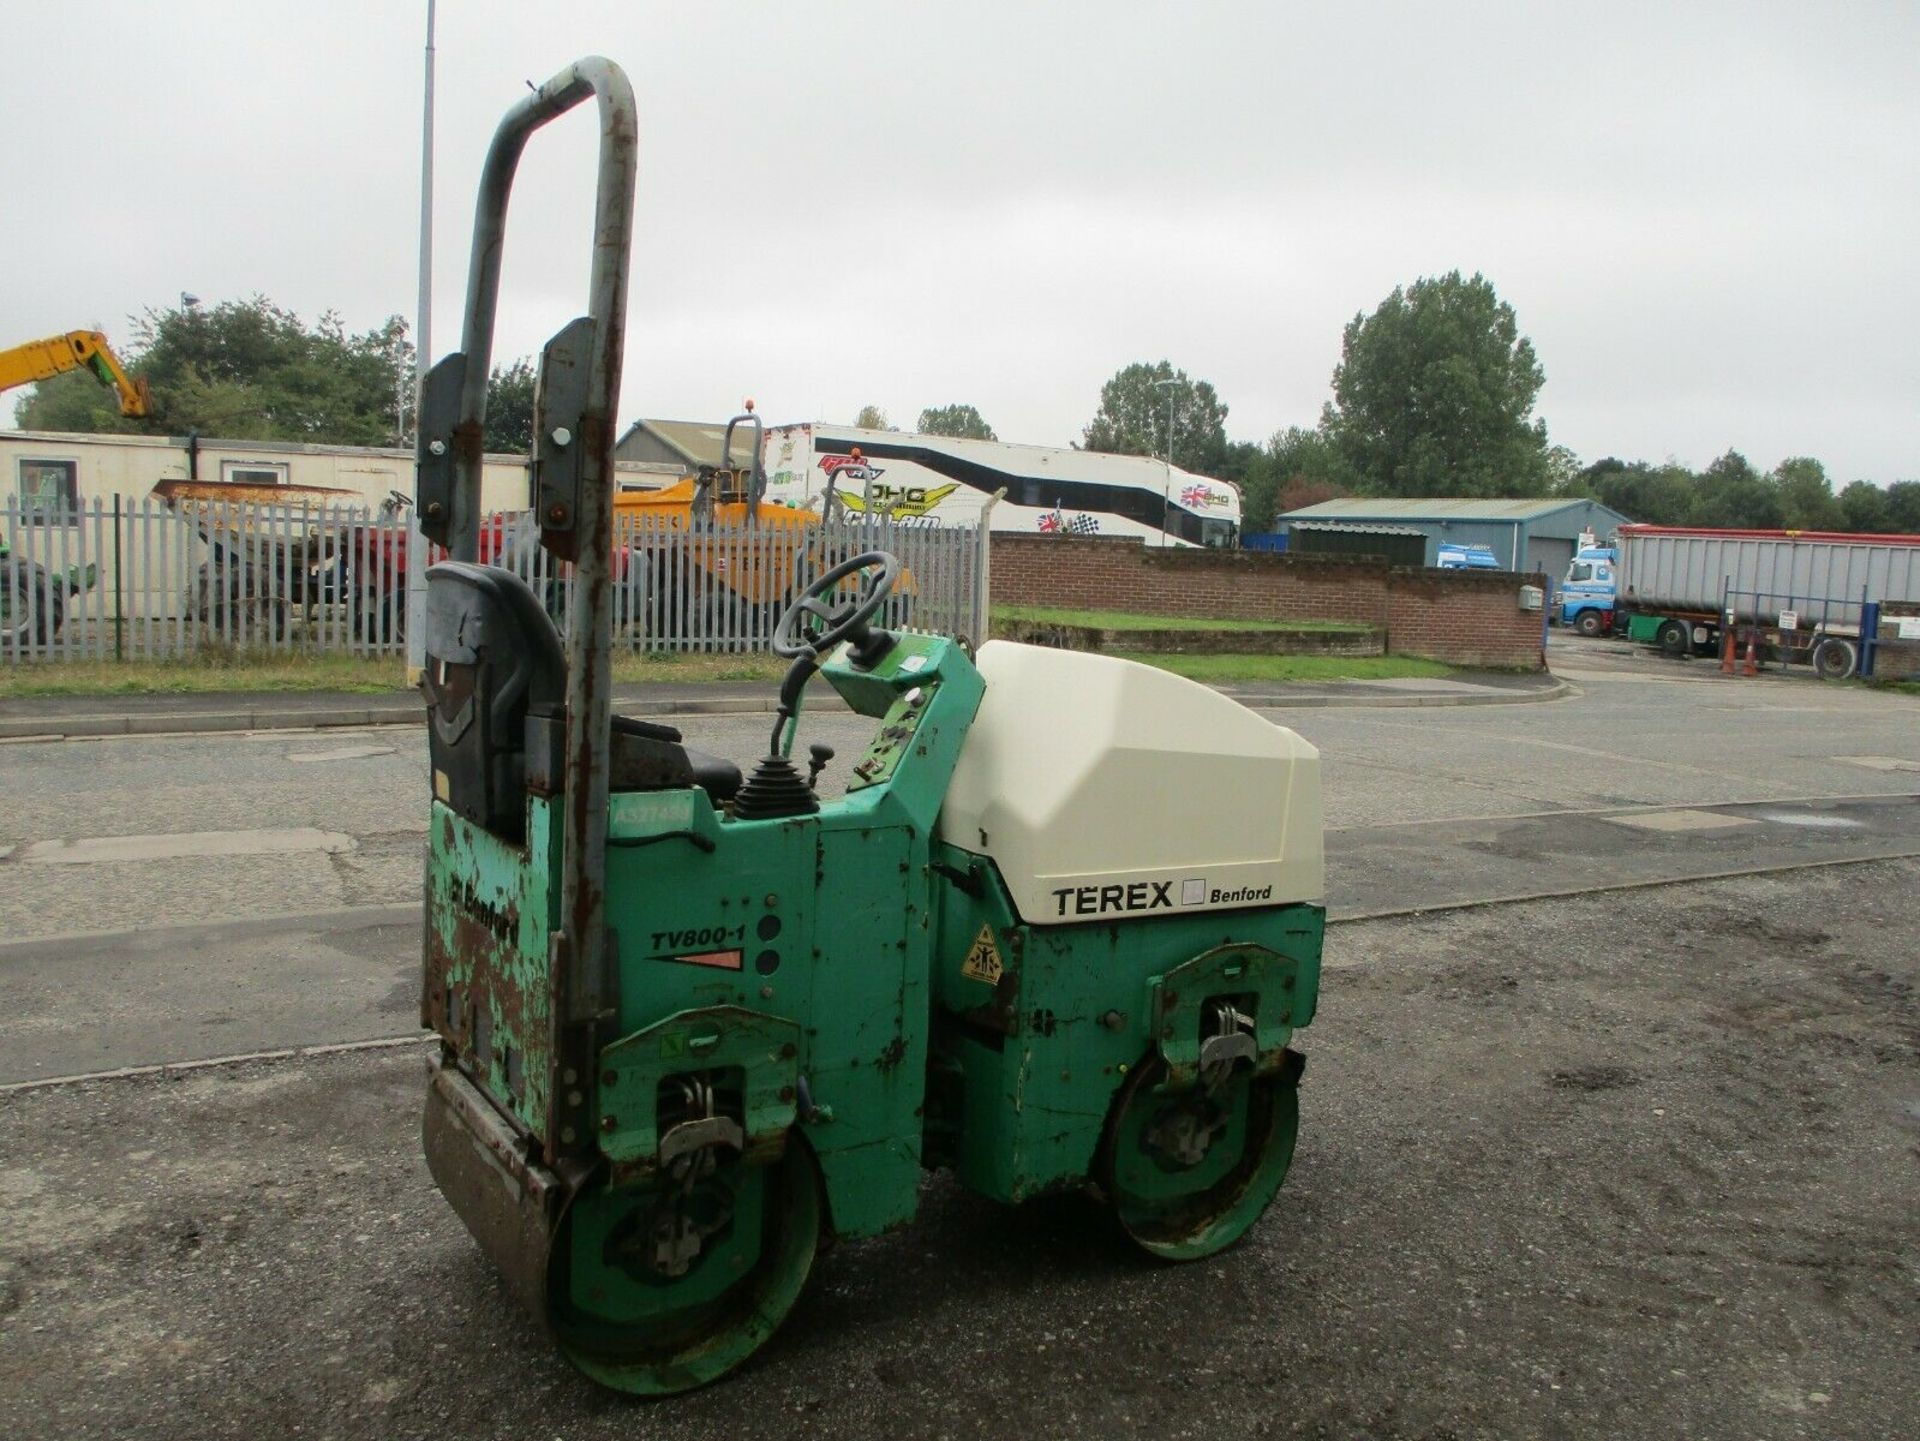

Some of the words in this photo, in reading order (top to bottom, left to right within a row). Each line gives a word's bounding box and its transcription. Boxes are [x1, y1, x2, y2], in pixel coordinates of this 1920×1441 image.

[1052, 881, 1173, 916] TEREX
[1210, 885, 1272, 904] Benford
[651, 924, 746, 950] TV800-1
